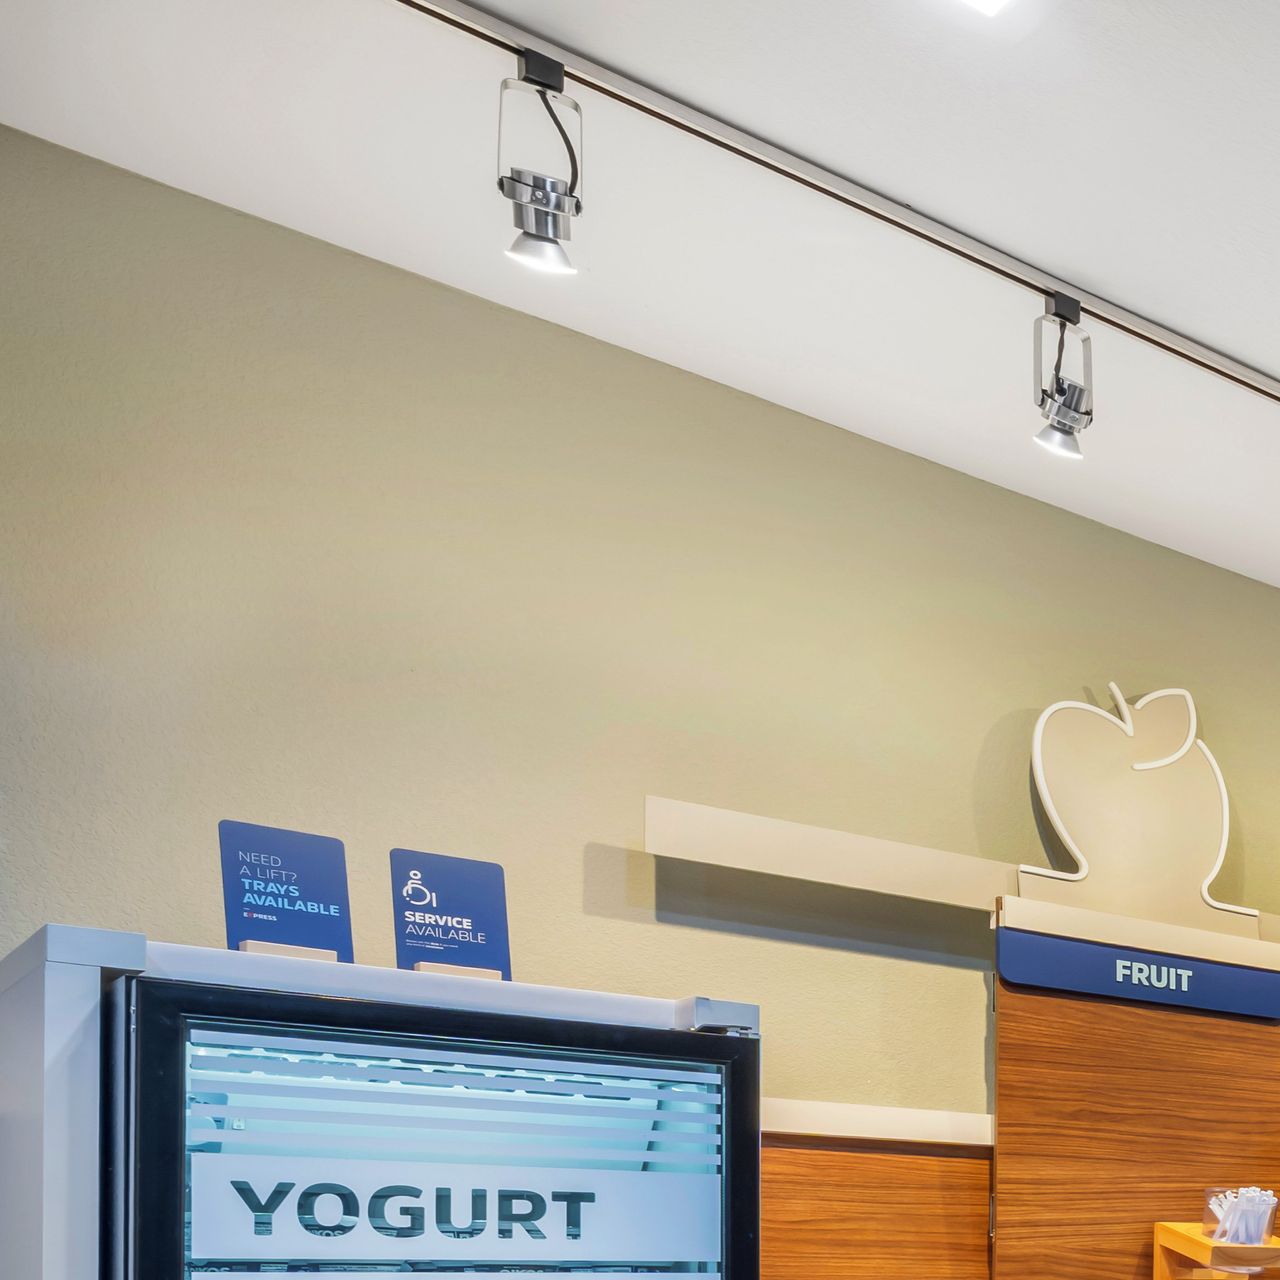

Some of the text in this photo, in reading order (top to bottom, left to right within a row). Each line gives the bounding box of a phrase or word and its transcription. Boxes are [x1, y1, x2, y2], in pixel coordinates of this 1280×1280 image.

[238, 851, 282, 867] NEED
[240, 865, 297, 882] A LIFT?
[241, 878, 300, 897] TRAYS
[242, 892, 340, 917] AVAILABLE
[243, 911, 277, 921] EXPRESS
[404, 910, 473, 930] SERVICE
[405, 923, 487, 944] AVAILABLE
[1116, 959, 1193, 991] FRUIT
[230, 1180, 596, 1241] YOGURT
